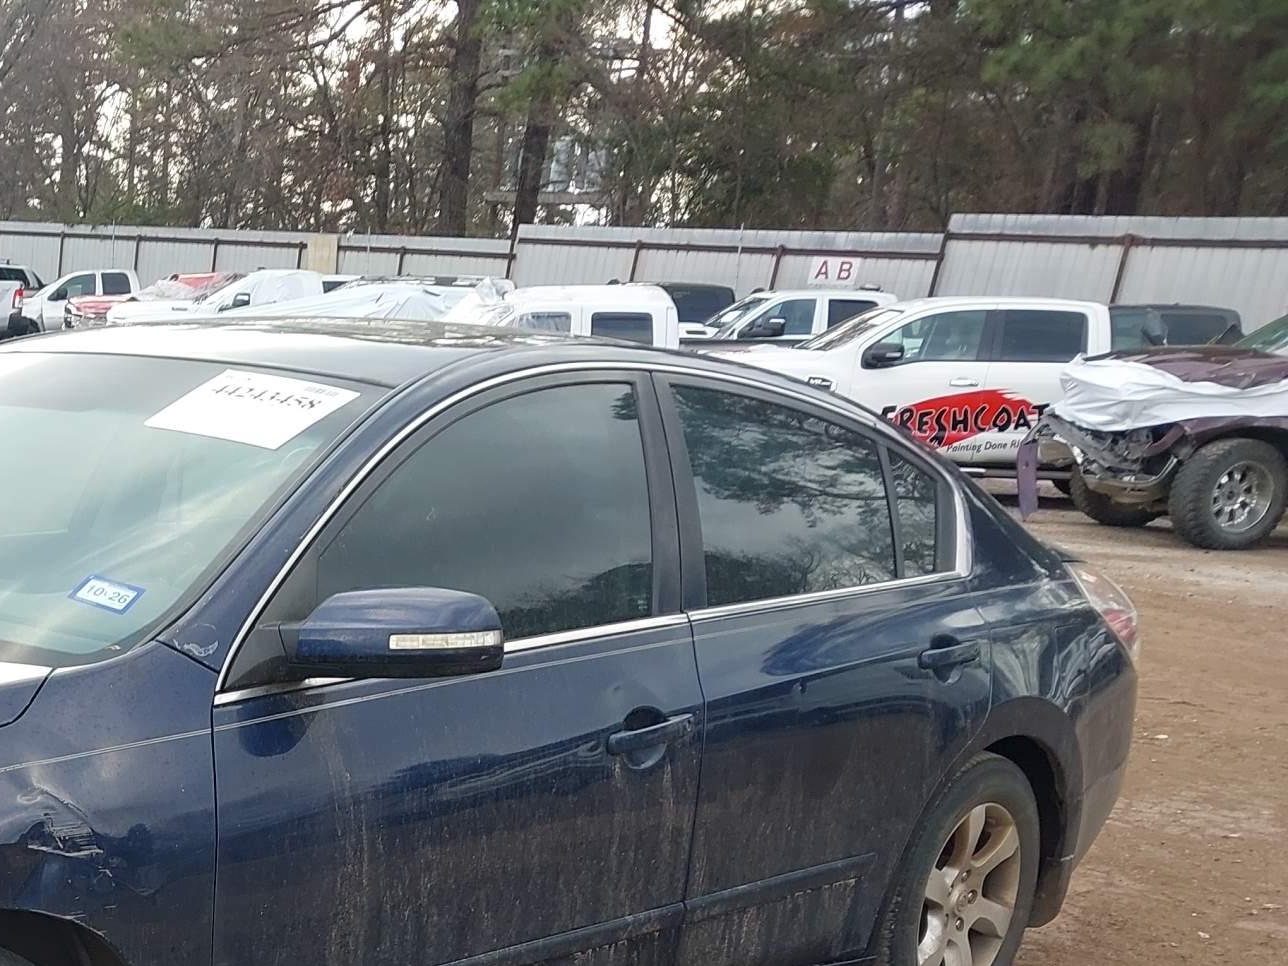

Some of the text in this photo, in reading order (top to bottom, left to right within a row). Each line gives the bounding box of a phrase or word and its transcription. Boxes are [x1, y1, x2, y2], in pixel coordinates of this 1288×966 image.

[815, 260, 853, 281] A B
[947, 442, 983, 453] Painting
[984, 440, 1008, 450] Done
[108, 591, 131, 604] 26
